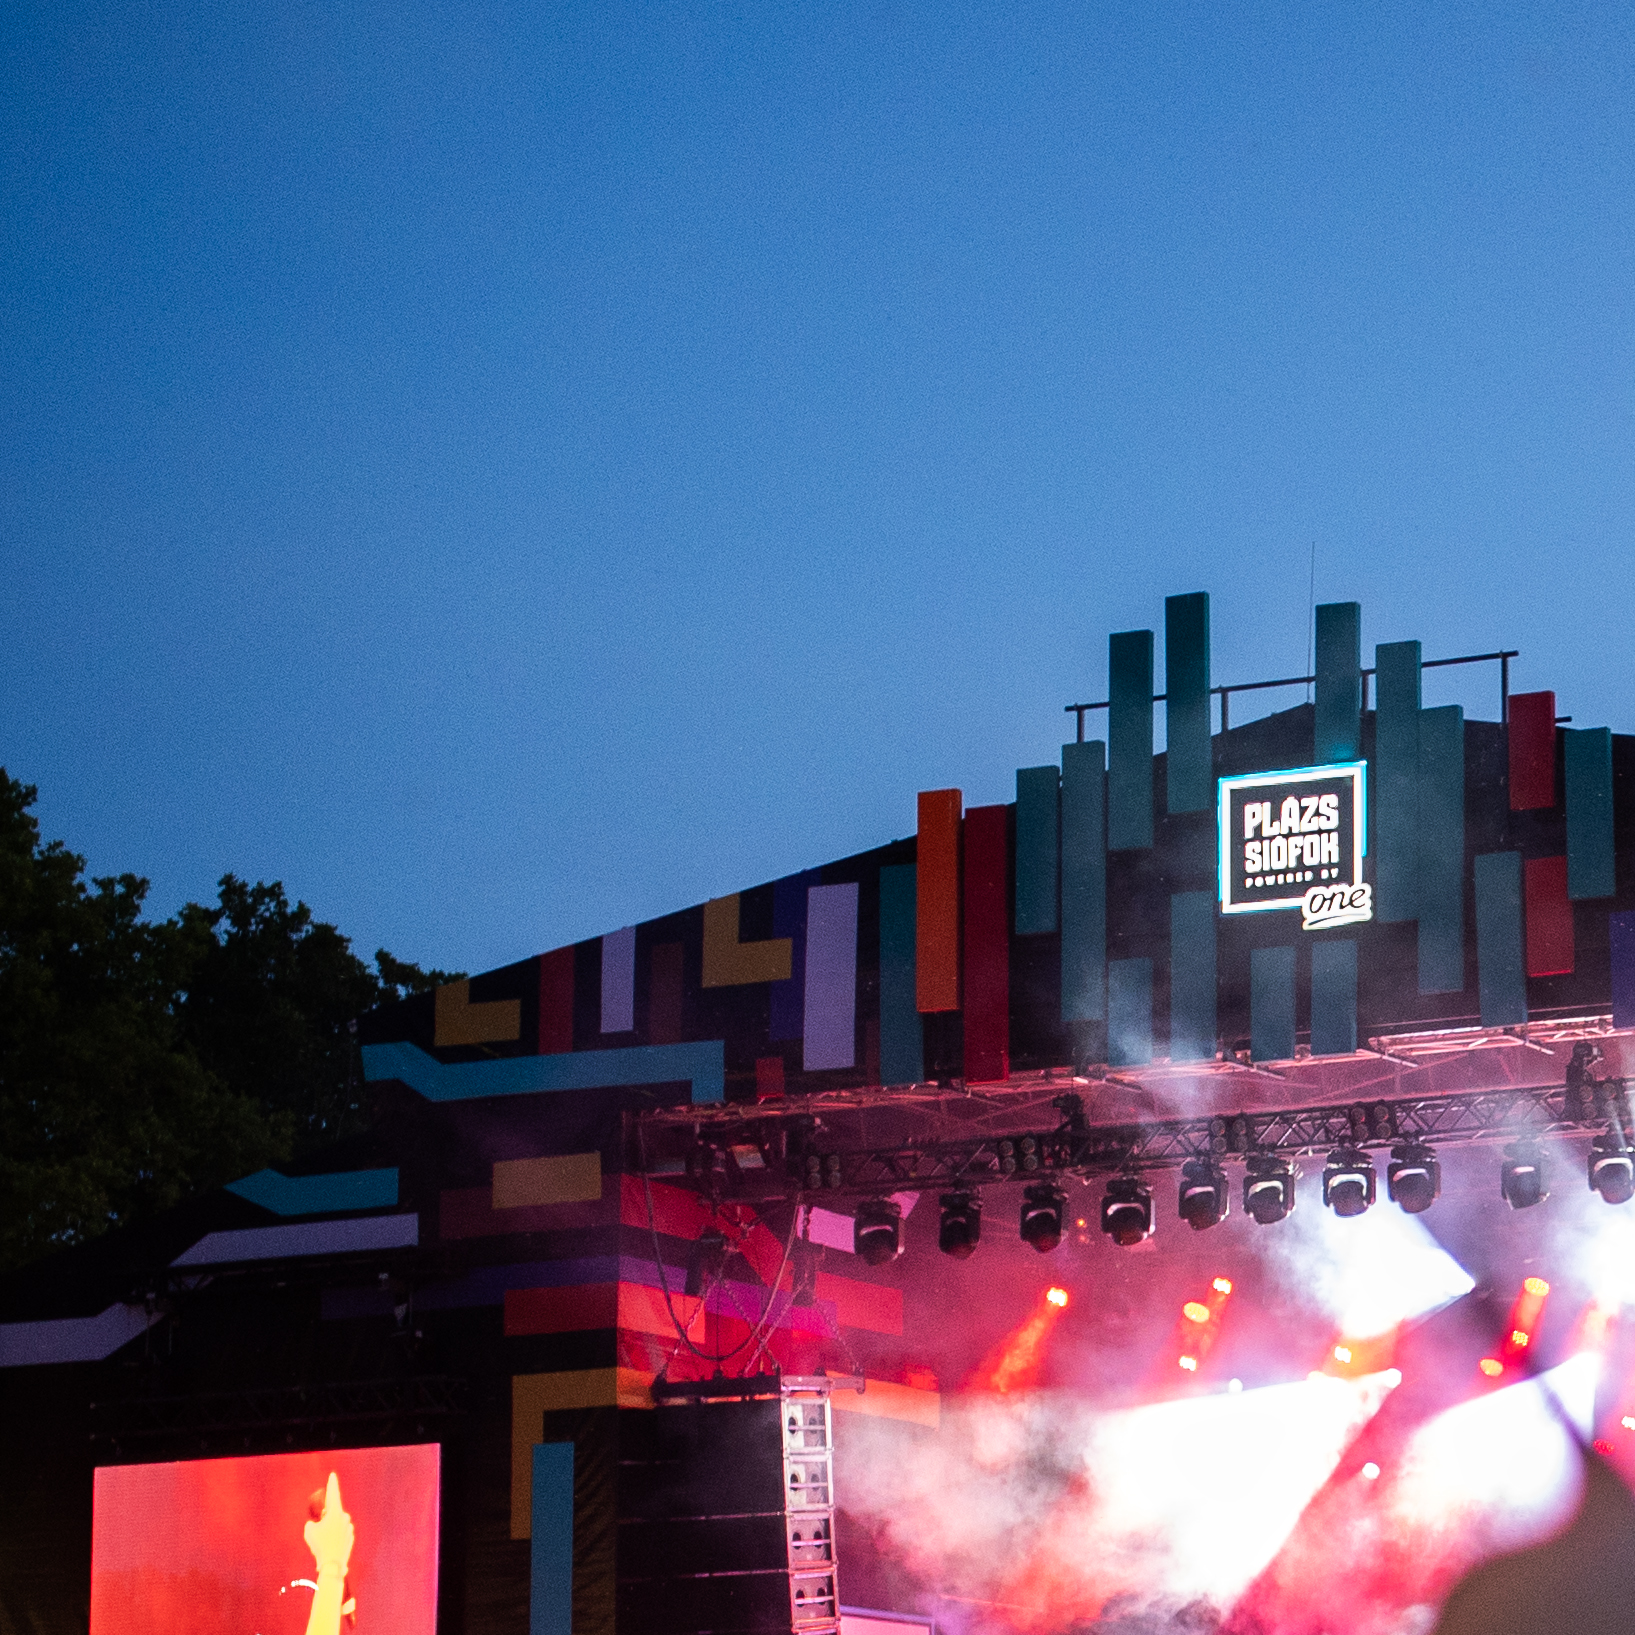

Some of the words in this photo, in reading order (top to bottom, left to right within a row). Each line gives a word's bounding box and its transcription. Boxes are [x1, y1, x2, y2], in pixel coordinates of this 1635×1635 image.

[1245, 872, 1313, 888] POWERED
[1320, 868, 1339, 880] BY
[1309, 888, 1367, 914] one
